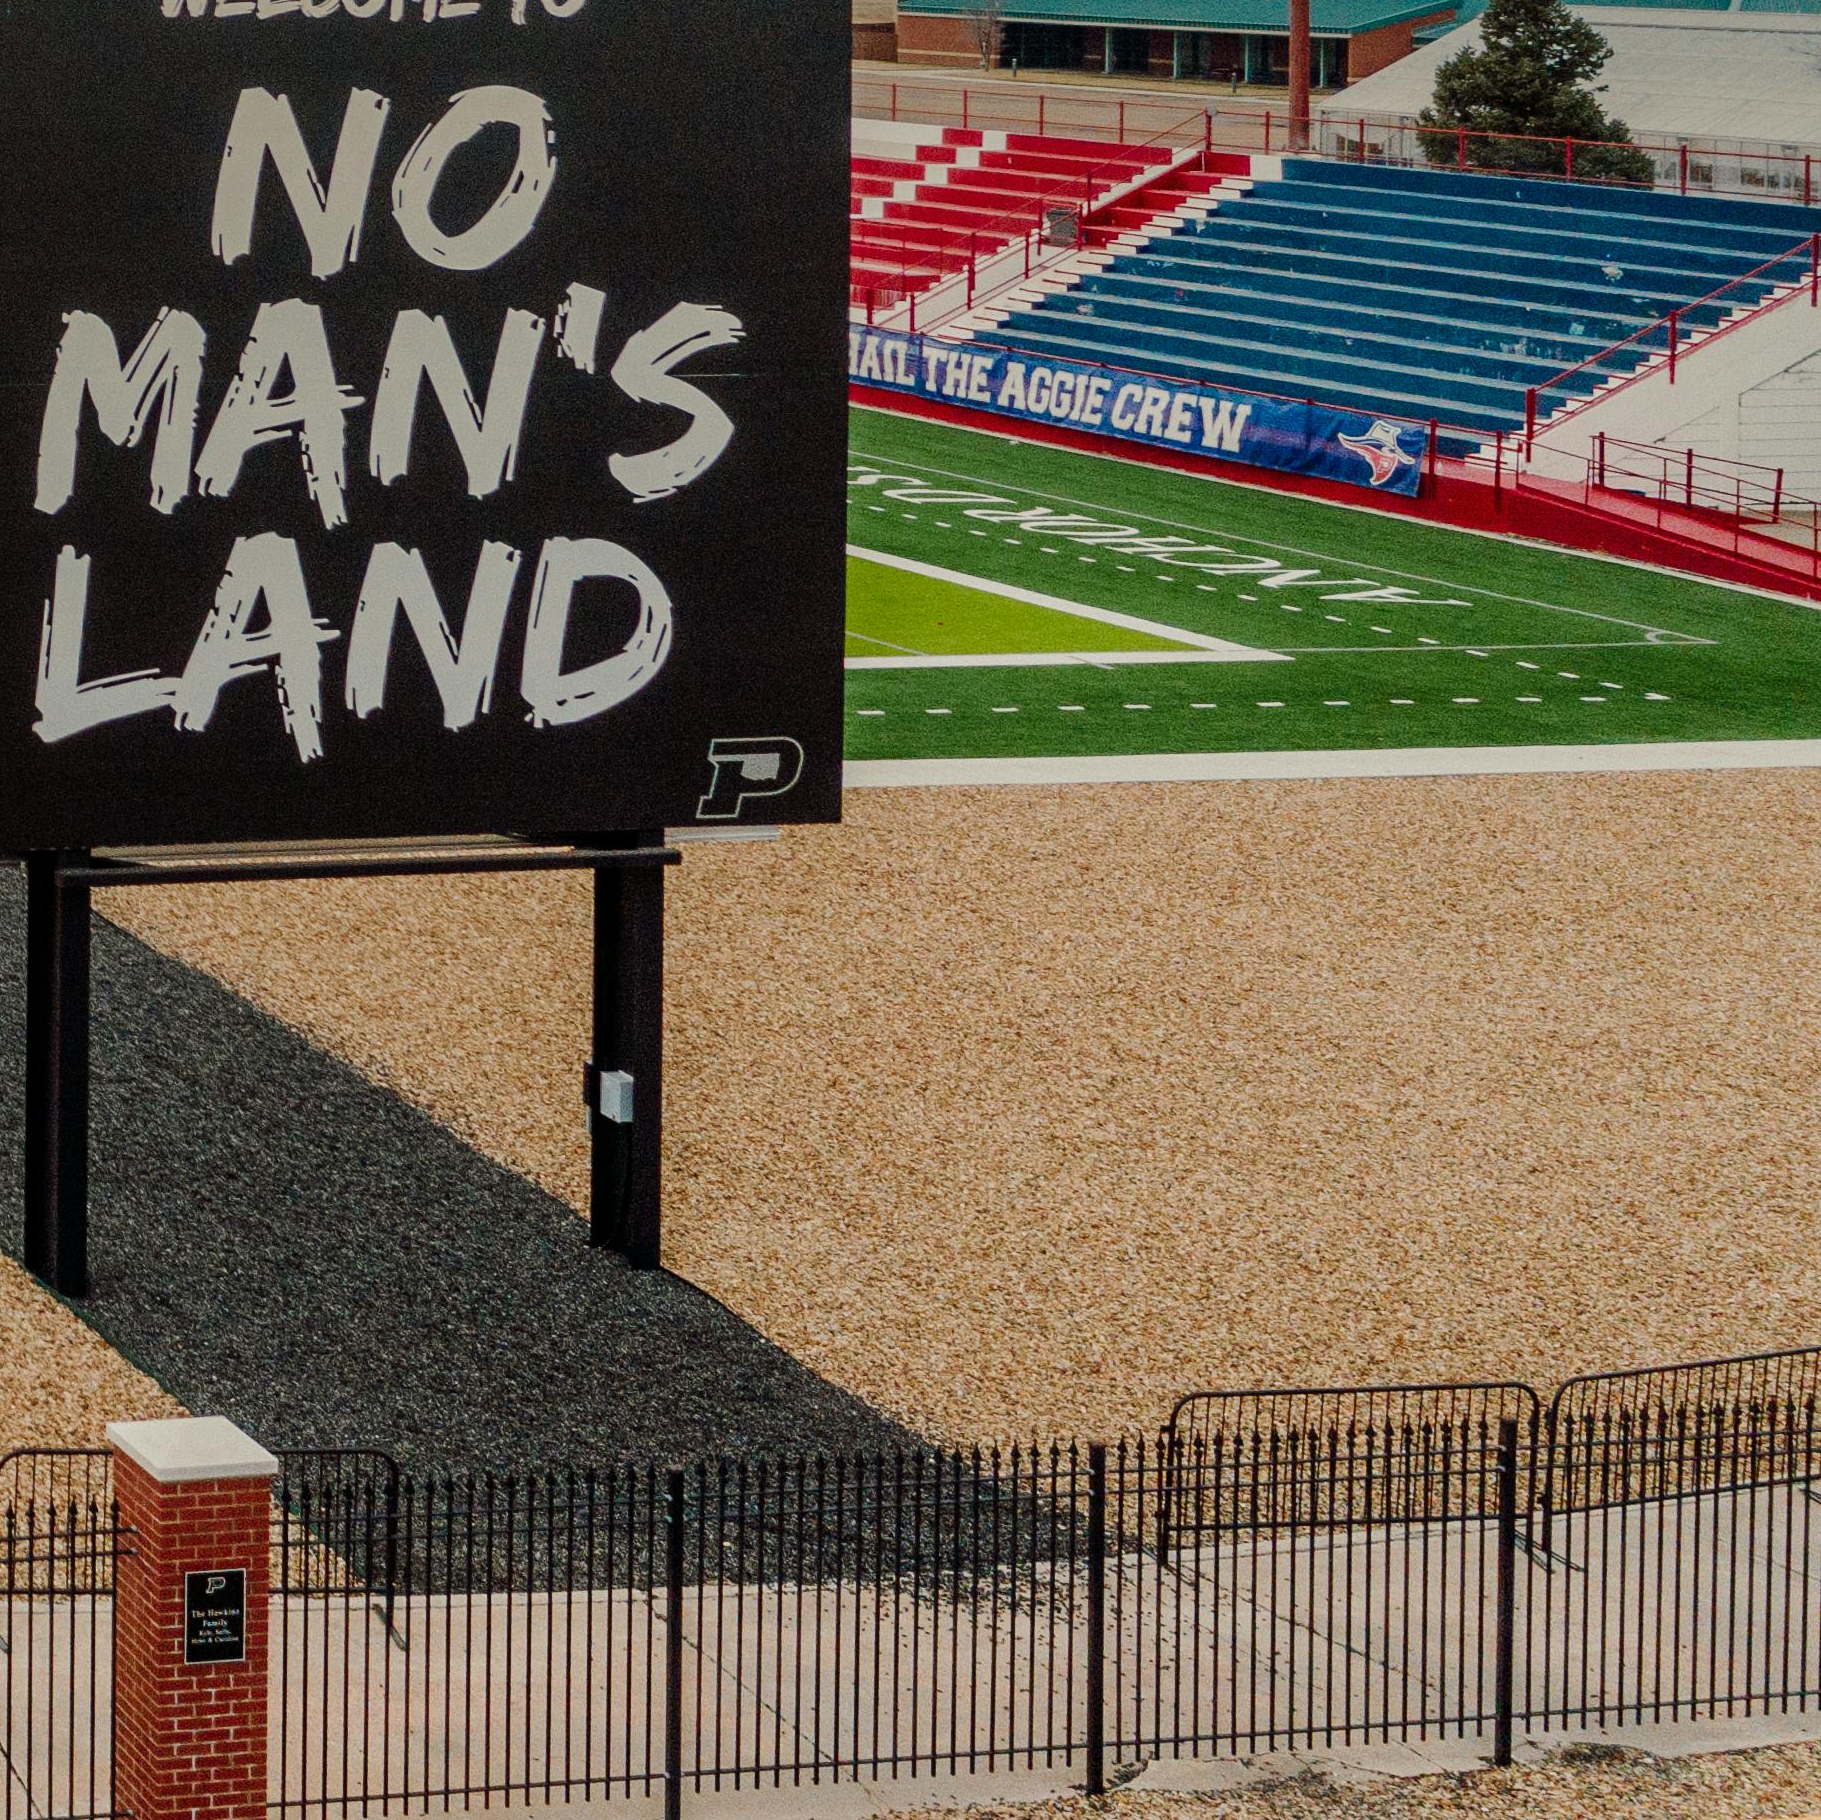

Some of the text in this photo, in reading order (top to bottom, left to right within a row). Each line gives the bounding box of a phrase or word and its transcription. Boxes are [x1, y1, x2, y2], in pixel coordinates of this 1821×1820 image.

[211, 84, 558, 279] NO
[33, 282, 747, 530] MAN'S
[922, 345, 994, 404] THE
[997, 361, 1112, 426] AGGIE
[1111, 383, 1252, 453] CREW
[963, 507, 1474, 607] ANCHOR
[32, 532, 673, 764] LAND
[695, 736, 805, 819] P
[202, 1618, 228, 1628] Family
